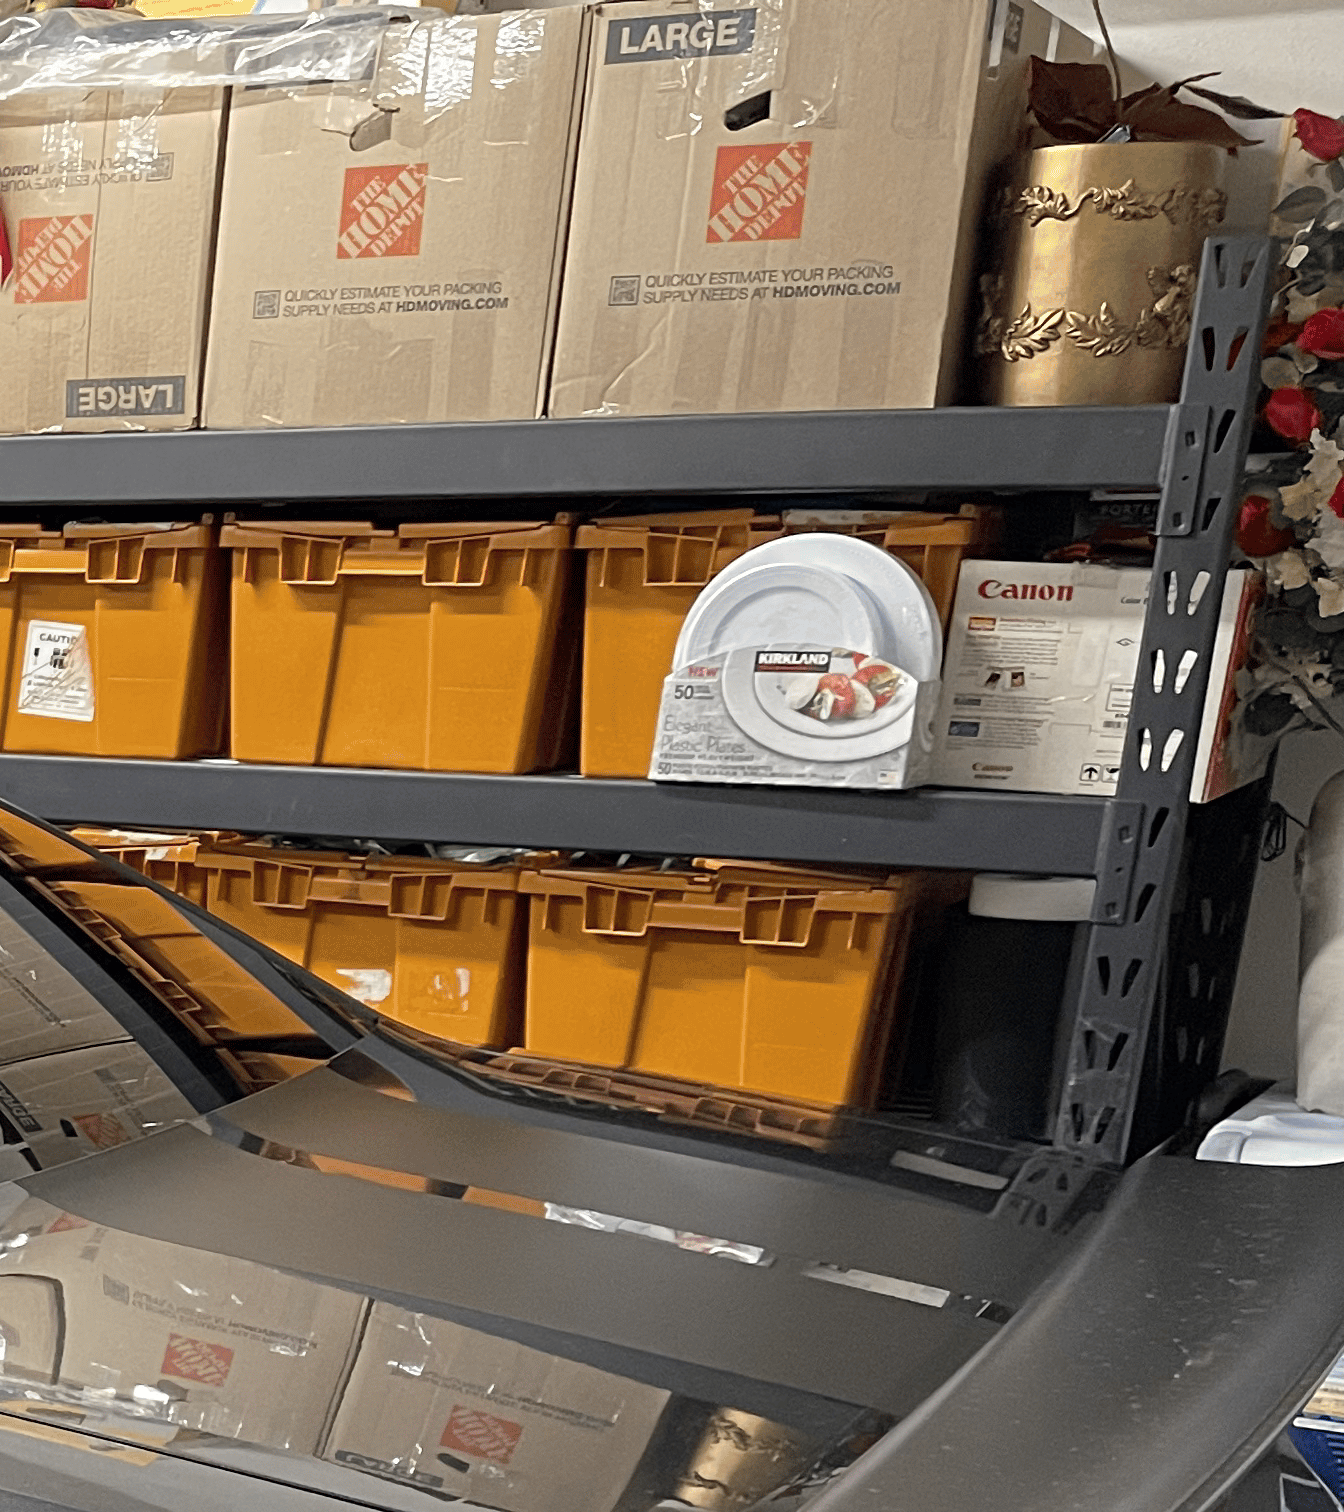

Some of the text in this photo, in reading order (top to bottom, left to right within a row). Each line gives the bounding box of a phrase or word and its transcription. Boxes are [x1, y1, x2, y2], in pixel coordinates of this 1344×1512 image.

[619, 17, 740, 54] LARGE
[722, 154, 763, 195] THE
[350, 175, 387, 213] THE
[708, 141, 810, 242] HOME
[338, 164, 428, 259] HOME
[645, 265, 894, 288] QUICKLY ESTIMATE YOUR PACKING
[284, 281, 502, 303] QUICKLY ESTIMATE YOUR PACKING
[643, 282, 901, 304] SUPPLY NEEDS AT HDMOVING.COM
[282, 297, 509, 318] SUPPLY NEEDS AT HDMOVING.COM
[78, 383, 174, 411] LARGE
[977, 579, 1074, 602] Canon
[39, 632, 78, 644] CAUTIO
[758, 652, 829, 665] KIRKLAND
[674, 684, 694, 700] 50
[664, 714, 712, 734] Elegant
[706, 736, 746, 752] Plates
